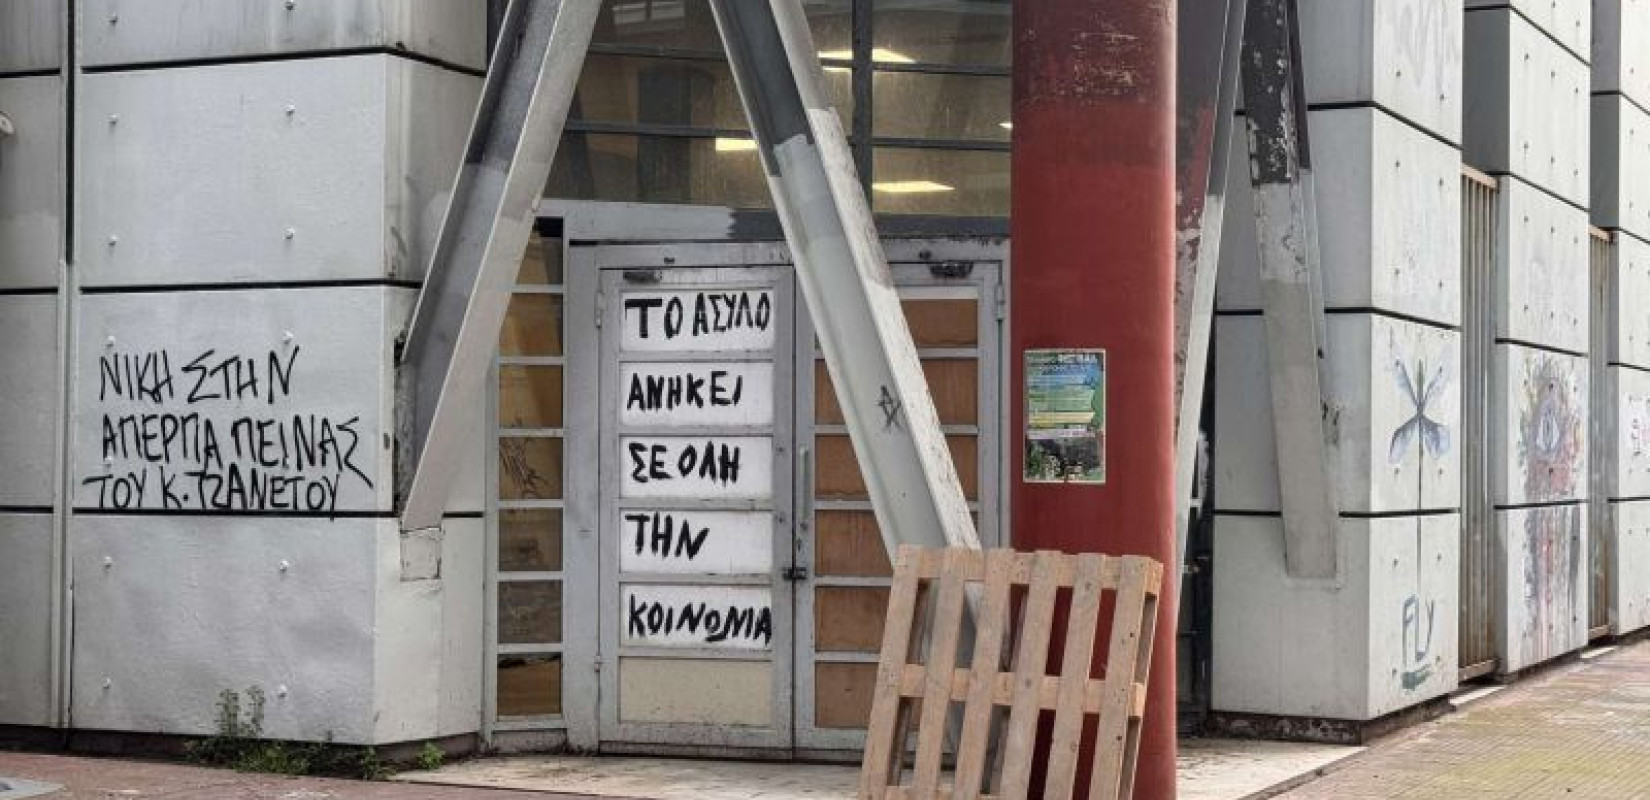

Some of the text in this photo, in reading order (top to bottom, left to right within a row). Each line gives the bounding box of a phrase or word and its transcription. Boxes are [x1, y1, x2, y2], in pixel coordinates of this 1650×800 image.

[625, 292, 770, 340] ΤΟ ΑΣΥΛΟ
[99, 350, 174, 404] ΝΙΚΗ
[627, 371, 743, 412] ΑΝΗΚΕΙ
[230, 413, 374, 489] ΠΕΙΝΑΣ
[628, 440, 741, 487] ΣΕ ΟΛΗ
[82, 468, 146, 509] ΤΟΥ
[625, 511, 710, 561] ΤΗΝ
[629, 593, 772, 645] ΚΟΙΝΩΝΙΑ
